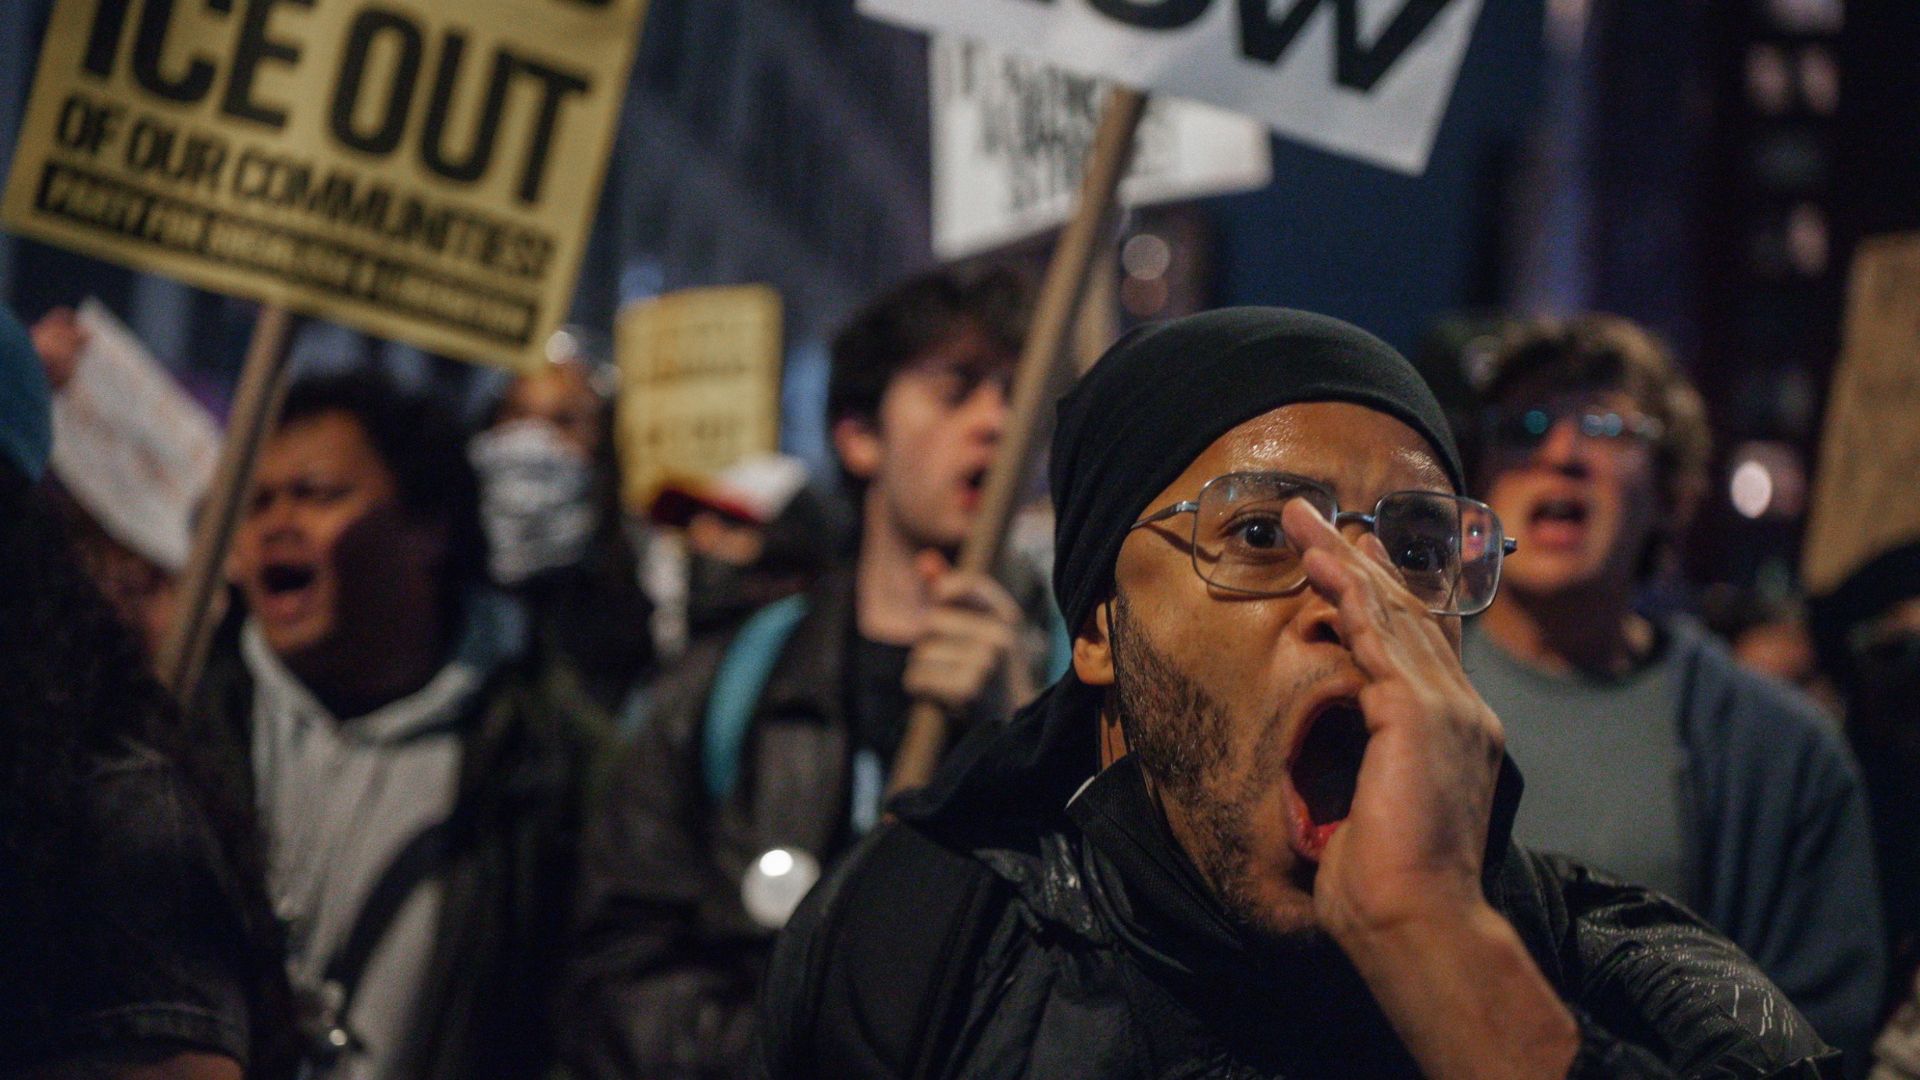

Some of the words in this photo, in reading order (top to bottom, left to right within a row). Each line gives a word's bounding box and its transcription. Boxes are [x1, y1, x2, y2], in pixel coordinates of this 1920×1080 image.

[57, 97, 123, 155] OF
[127, 116, 228, 191] OUR
[235, 145, 557, 278] COMMUNITIES!
[82, 0, 314, 128] ICE
[329, 9, 592, 207] OUT
